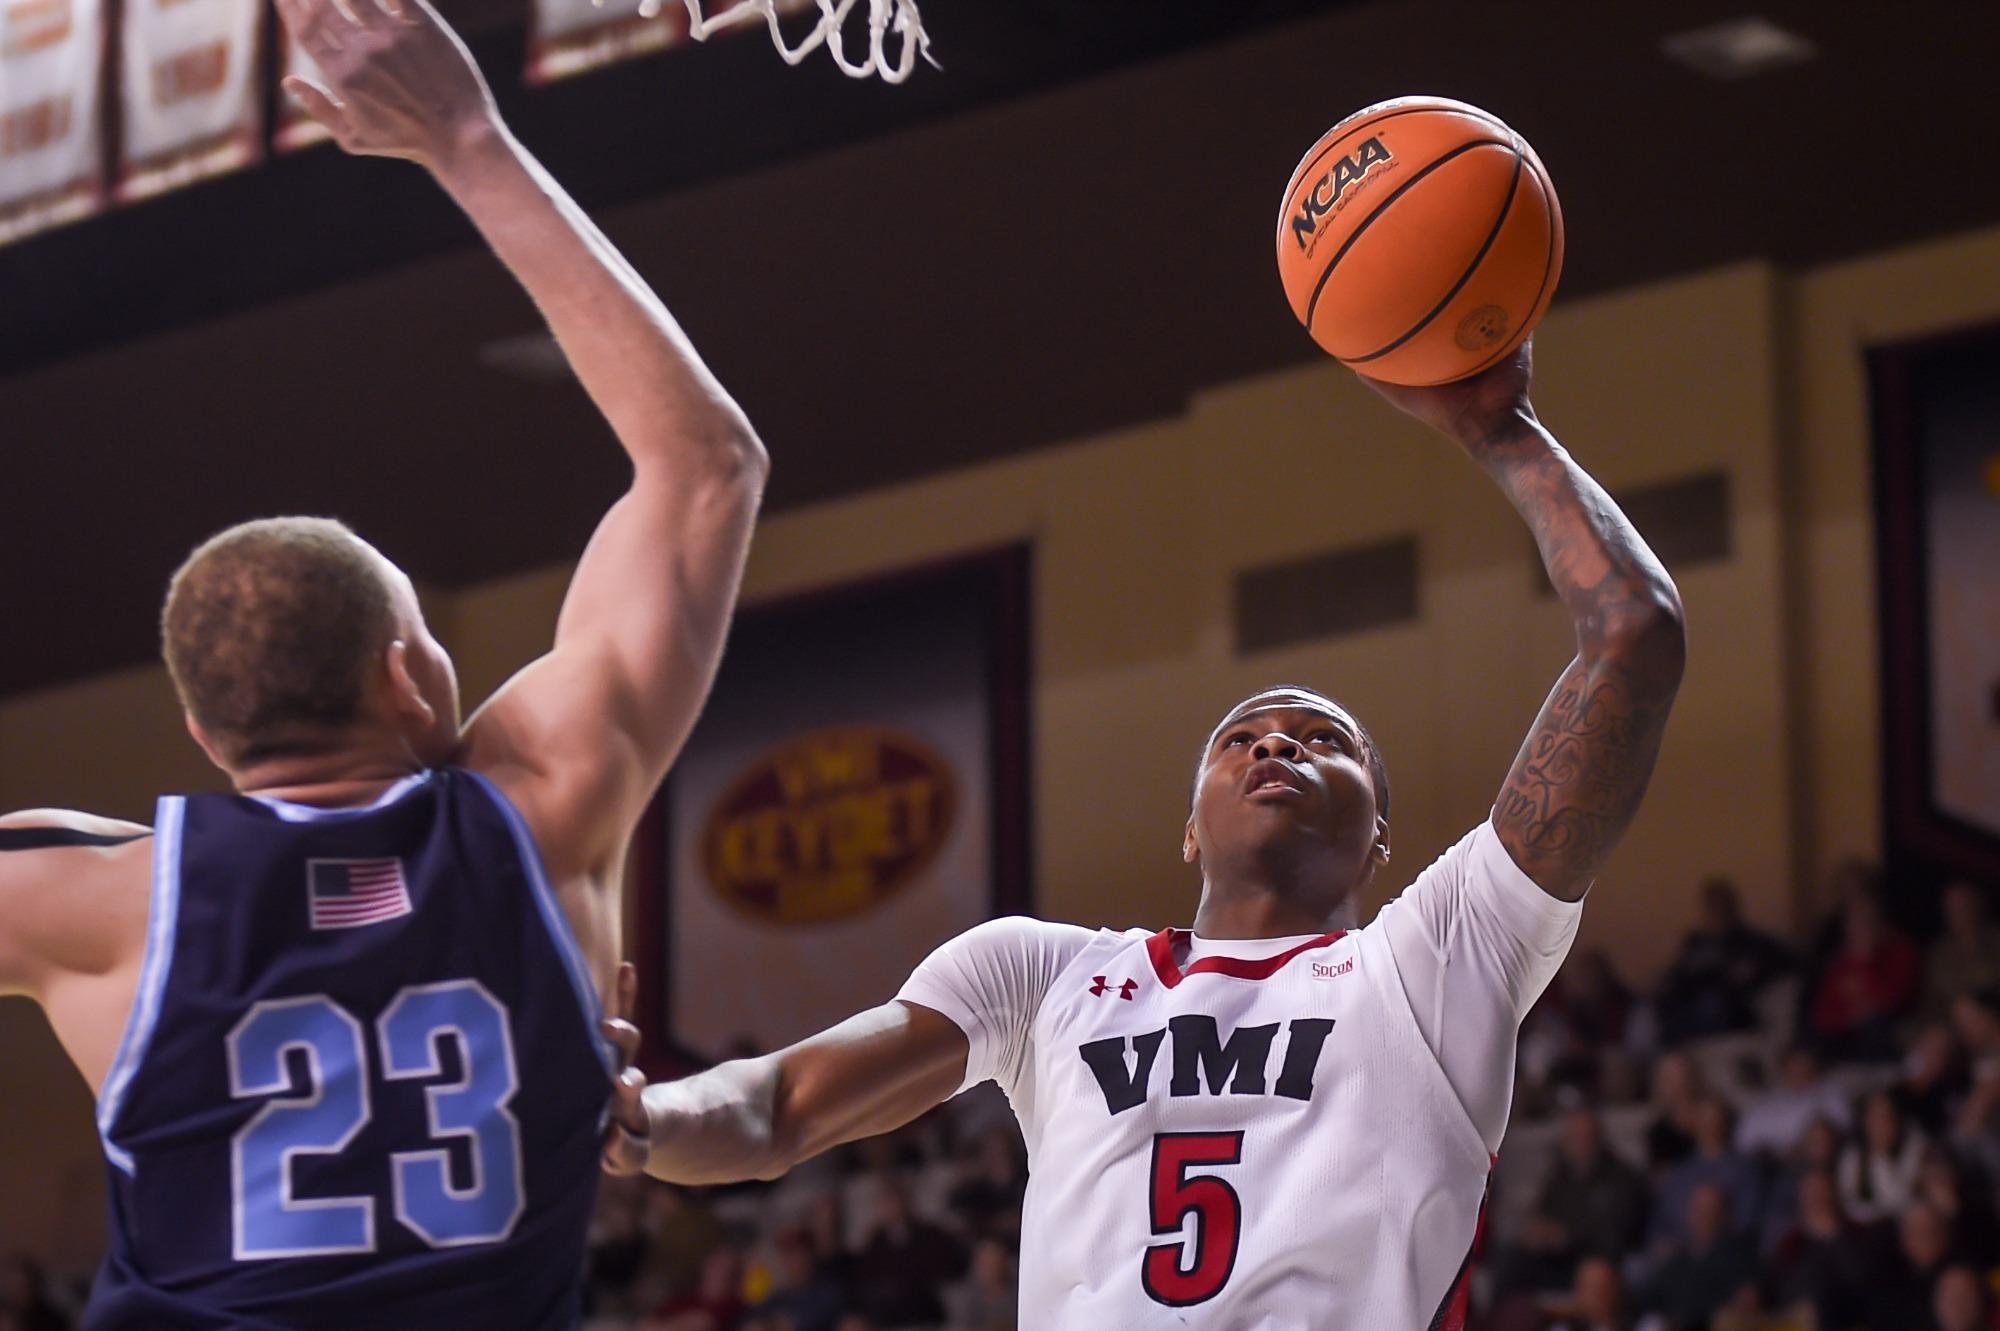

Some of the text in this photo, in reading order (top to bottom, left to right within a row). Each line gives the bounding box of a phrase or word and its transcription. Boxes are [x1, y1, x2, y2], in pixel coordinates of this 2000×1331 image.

[1292, 136, 1394, 252] NCAA
[1312, 956, 1354, 978] SOCON
[224, 977, 526, 1261] 23
[1078, 1014, 1336, 1116] VMI
[1141, 1130, 1245, 1308] 5
